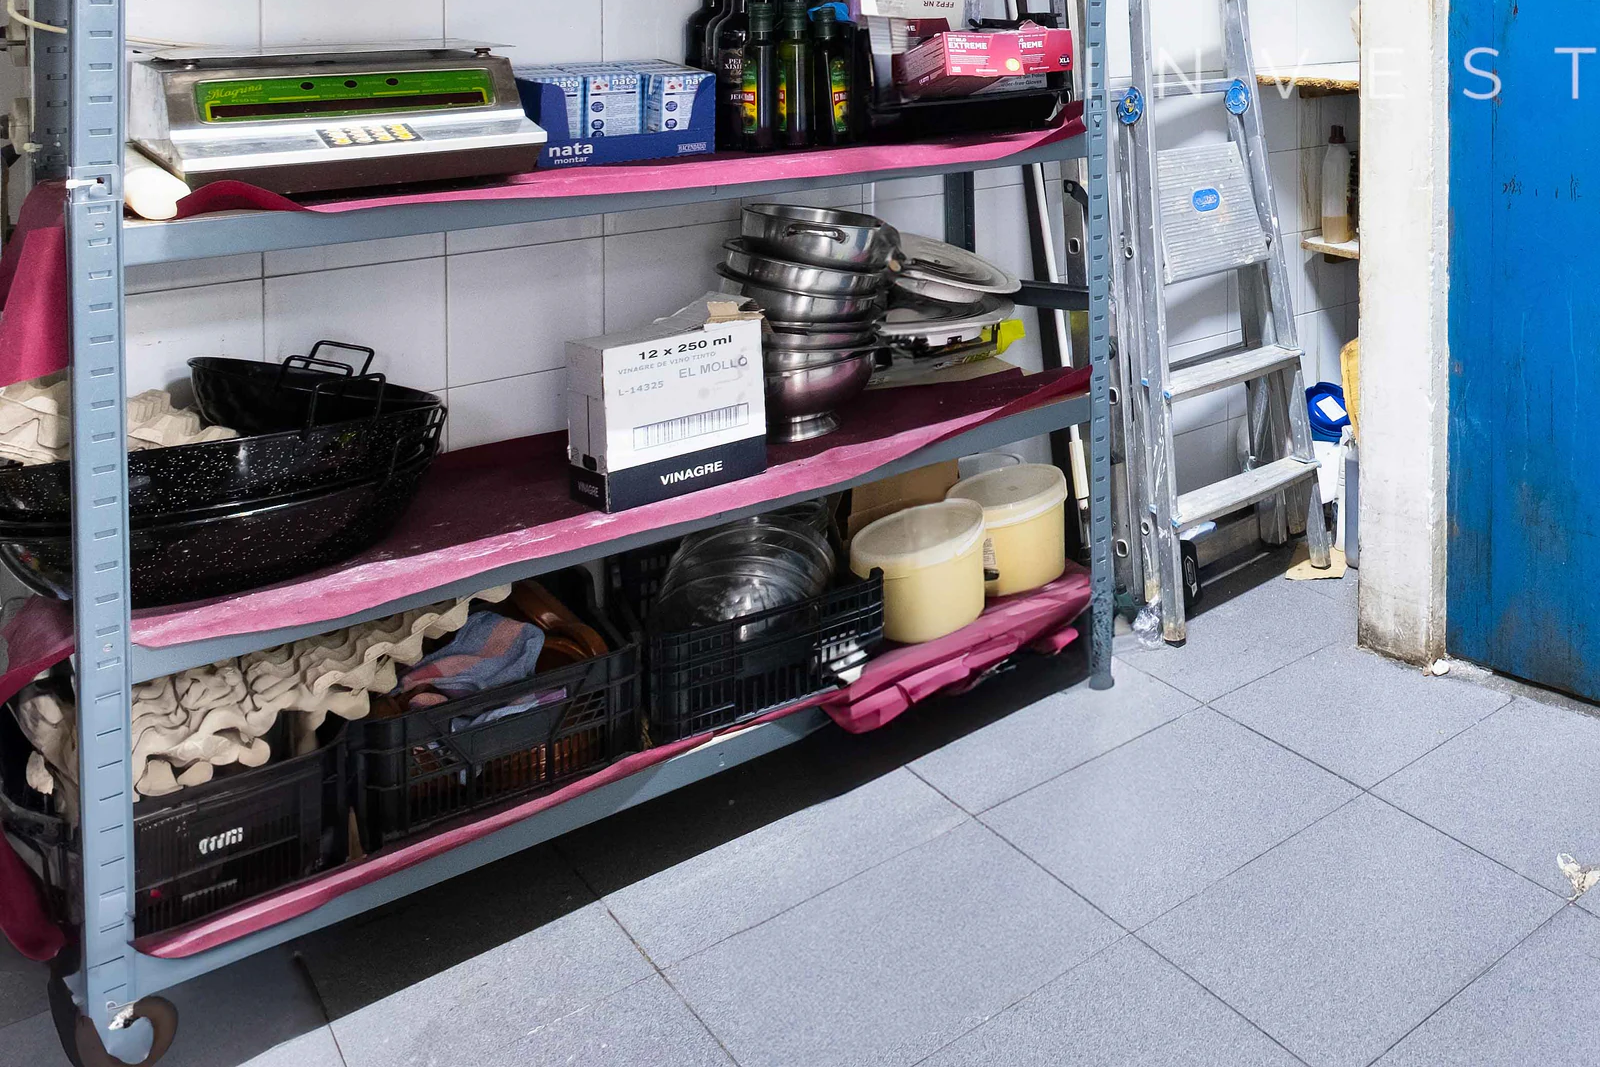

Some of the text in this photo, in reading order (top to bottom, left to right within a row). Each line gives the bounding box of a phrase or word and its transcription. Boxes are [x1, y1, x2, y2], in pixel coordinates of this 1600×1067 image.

[948, 41, 988, 50] EXTREME
[612, 76, 638, 86] nata
[548, 142, 594, 157] nata
[554, 156, 589, 165] montar
[639, 335, 732, 360] 12 x 250 ml
[618, 363, 655, 375] VINAGRE
[670, 356, 690, 365] VINO
[692, 351, 716, 361] TINTO
[679, 367, 696, 379] EL
[618, 380, 664, 396] L-14325
[660, 460, 723, 486] VINAGRE
[577, 480, 599, 498] VINAGRE
